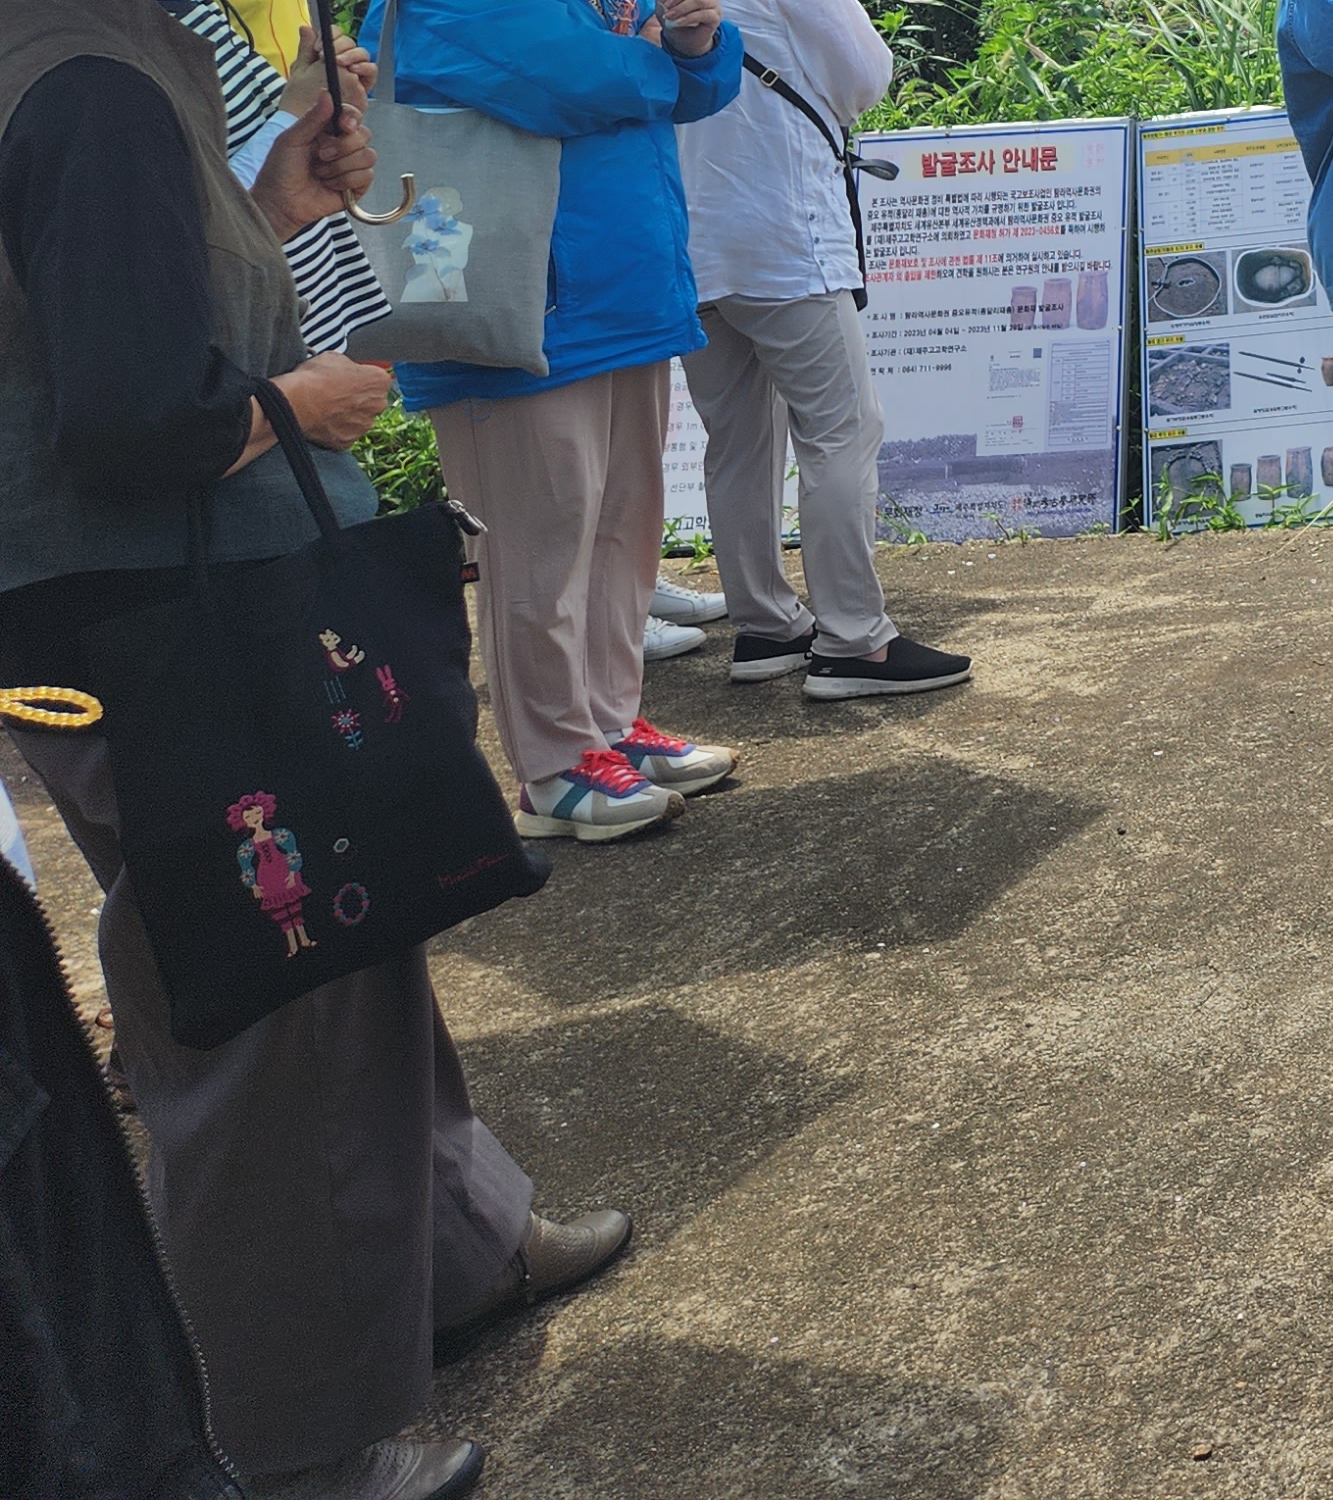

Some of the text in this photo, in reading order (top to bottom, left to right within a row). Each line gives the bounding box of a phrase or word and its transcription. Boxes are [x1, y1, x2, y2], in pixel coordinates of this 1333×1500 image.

[921, 148, 995, 178] 발굴조사
[1002, 145, 1058, 173] 안내문
[871, 198, 878, 208] 본
[879, 197, 898, 207] 조사는
[899, 194, 930, 206] 역사문화권
[945, 192, 969, 204] 특별법에
[970, 191, 983, 203] 따라
[985, 190, 1008, 202] 시행되는
[1010, 187, 1052, 200] 국고보조사업인
[1053, 185, 1101, 199] 탐라역사문화권의
[867, 210, 879, 221] 중요
[938, 205, 950, 217] 대한
[952, 204, 970, 217] 역사적
[971, 203, 989, 215] 가치를
[991, 202, 1016, 214] 규명하기
[1017, 201, 1029, 213] 위한
[1031, 200, 1055, 212] 발굴조사
[1056, 199, 1076, 210] 입니다.
[871, 209, 1103, 233] 제주특별자치도 세계유산본부 세계유산정책과에서 탐라역사문화권 중요 유적 발굴조사
[866, 235, 872, 246] 를
[941, 230, 972, 241] 의뢰하였고
[973, 228, 997, 239] 문화재청
[998, 226, 1011, 238] 허가
[1012, 226, 1019, 237] 제
[1087, 222, 1106, 233] 시행하
[865, 245, 919, 258] 는 발굴조사 입니다.
[868, 248, 1083, 270] 조사는 문화재보호 및 조사에 관한 법률 제 11조에 의거하여 실시하고 있습니다.
[903, 270, 922, 281] 출입을
[955, 267, 975, 278] 견학을
[976, 265, 1000, 277] 원하시는
[1001, 265, 1014, 276] 분은
[1015, 263, 1040, 275] 연구원의
[1041, 262, 1059, 273] 안내를
[1061, 261, 1085, 273] 받으시길
[1086, 259, 1113, 271] 바랍니다.
[904, 309, 950, 320] 탐라역사문화권
[1016, 304, 1036, 314] 문화재
[1038, 302, 1064, 313] 발굴조사
[871, 323, 1007, 339] 조사기간 2023년 04월 04일 2023년 11월
[870, 344, 968, 357] 조사기관 (재)제주고고학연구소
[902, 365, 917, 374] 064)
[676, 401, 693, 412] 경우
[689, 441, 697, 451] 및
[670, 483, 695, 493] 선단부
